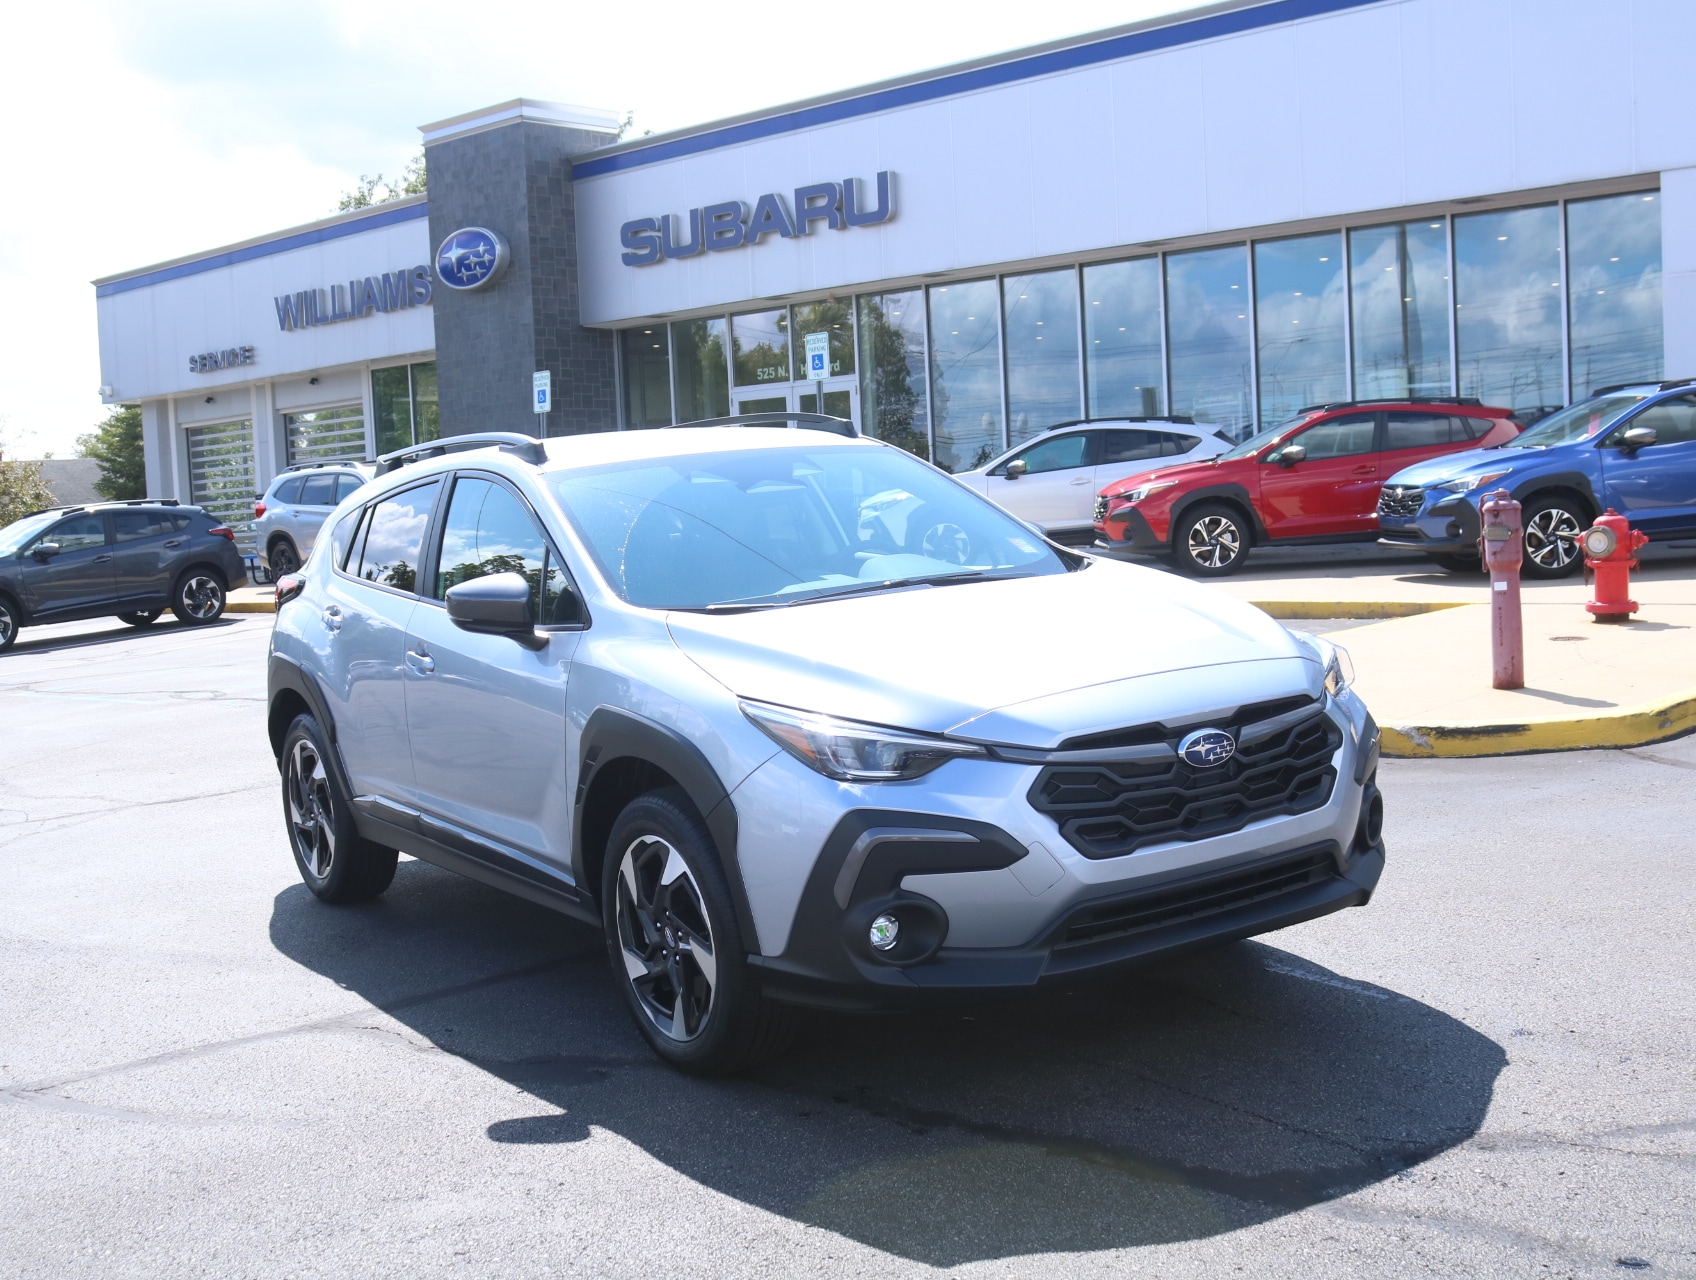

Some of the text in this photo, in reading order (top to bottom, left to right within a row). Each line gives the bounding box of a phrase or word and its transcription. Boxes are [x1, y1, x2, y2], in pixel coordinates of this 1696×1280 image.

[620, 170, 896, 267] SUBARU
[274, 265, 433, 331] WILLIAMS
[189, 346, 255, 373] SERVICE
[808, 344, 826, 352] PARKING
[757, 367, 775, 380] 525
[778, 365, 788, 378] N.
